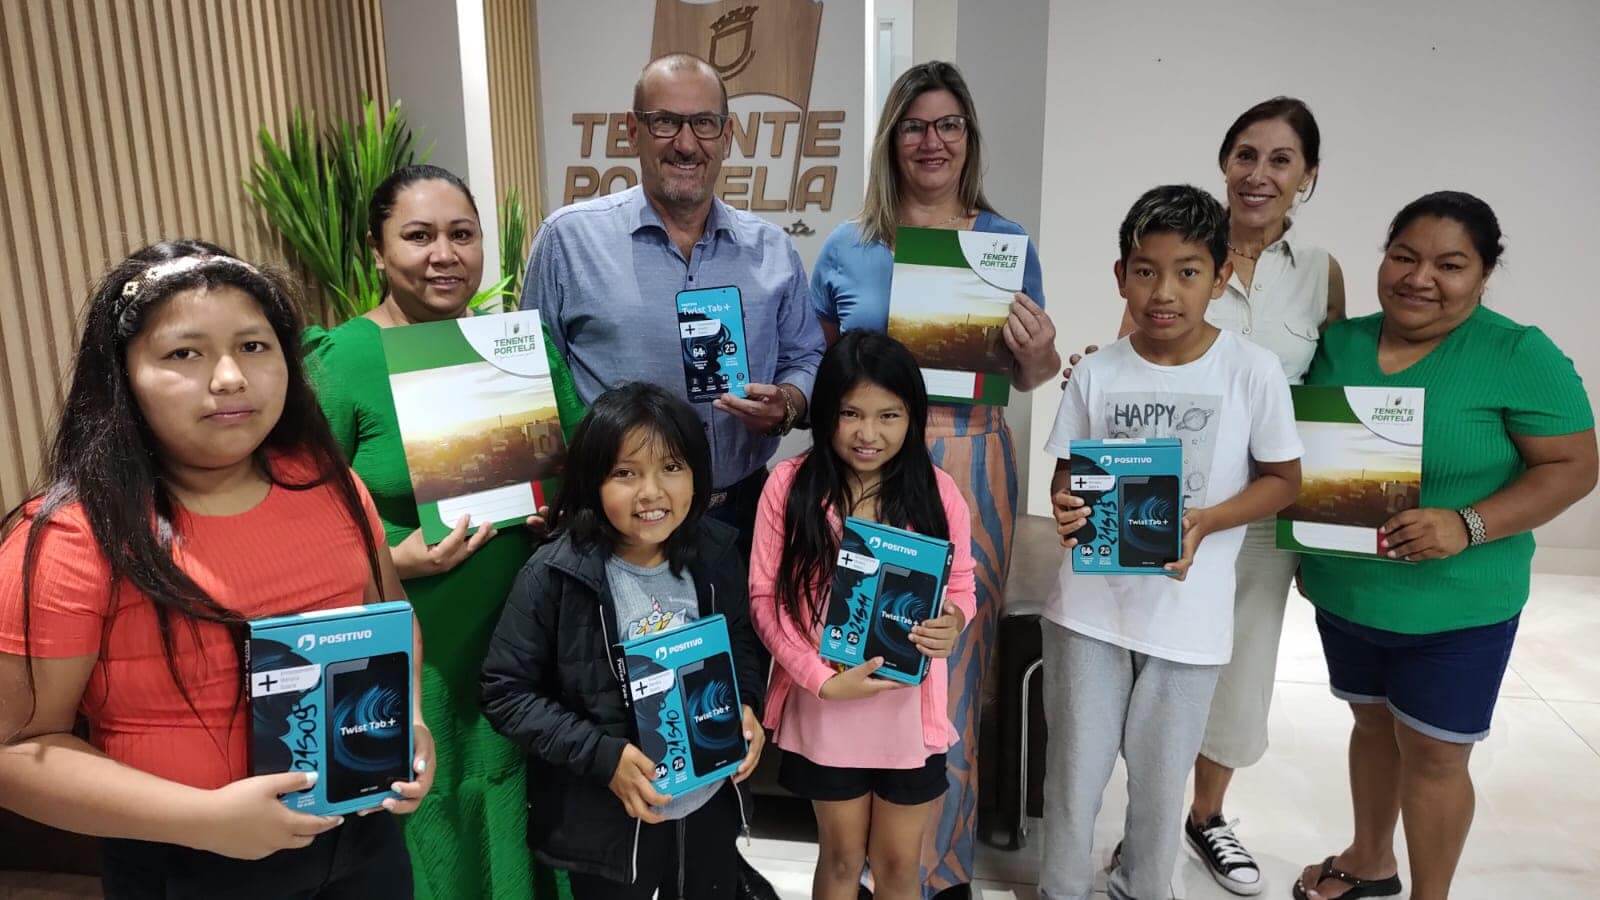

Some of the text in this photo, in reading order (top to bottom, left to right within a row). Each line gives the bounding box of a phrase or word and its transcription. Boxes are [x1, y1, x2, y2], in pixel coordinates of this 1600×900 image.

[571, 111, 846, 158] TENTE
[563, 166, 838, 212] POELA
[980, 260, 1017, 269] PORTELA
[983, 253, 1019, 262] TENENTE
[494, 335, 535, 347] TENENTE
[494, 343, 536, 356] PORTELA
[1114, 403, 1176, 428] HAPPY
[1374, 407, 1415, 415] TENENTE
[1114, 456, 1153, 464] POSITIVO
[882, 541, 918, 556] POSITIVO
[881, 610, 900, 622] Twist
[319, 629, 372, 646] POSITIVO
[668, 637, 703, 654] POSITIVO
[694, 711, 712, 723] Twist
[340, 724, 368, 737] Twist
[369, 719, 386, 730] Tab
[294, 703, 319, 772] 21509
